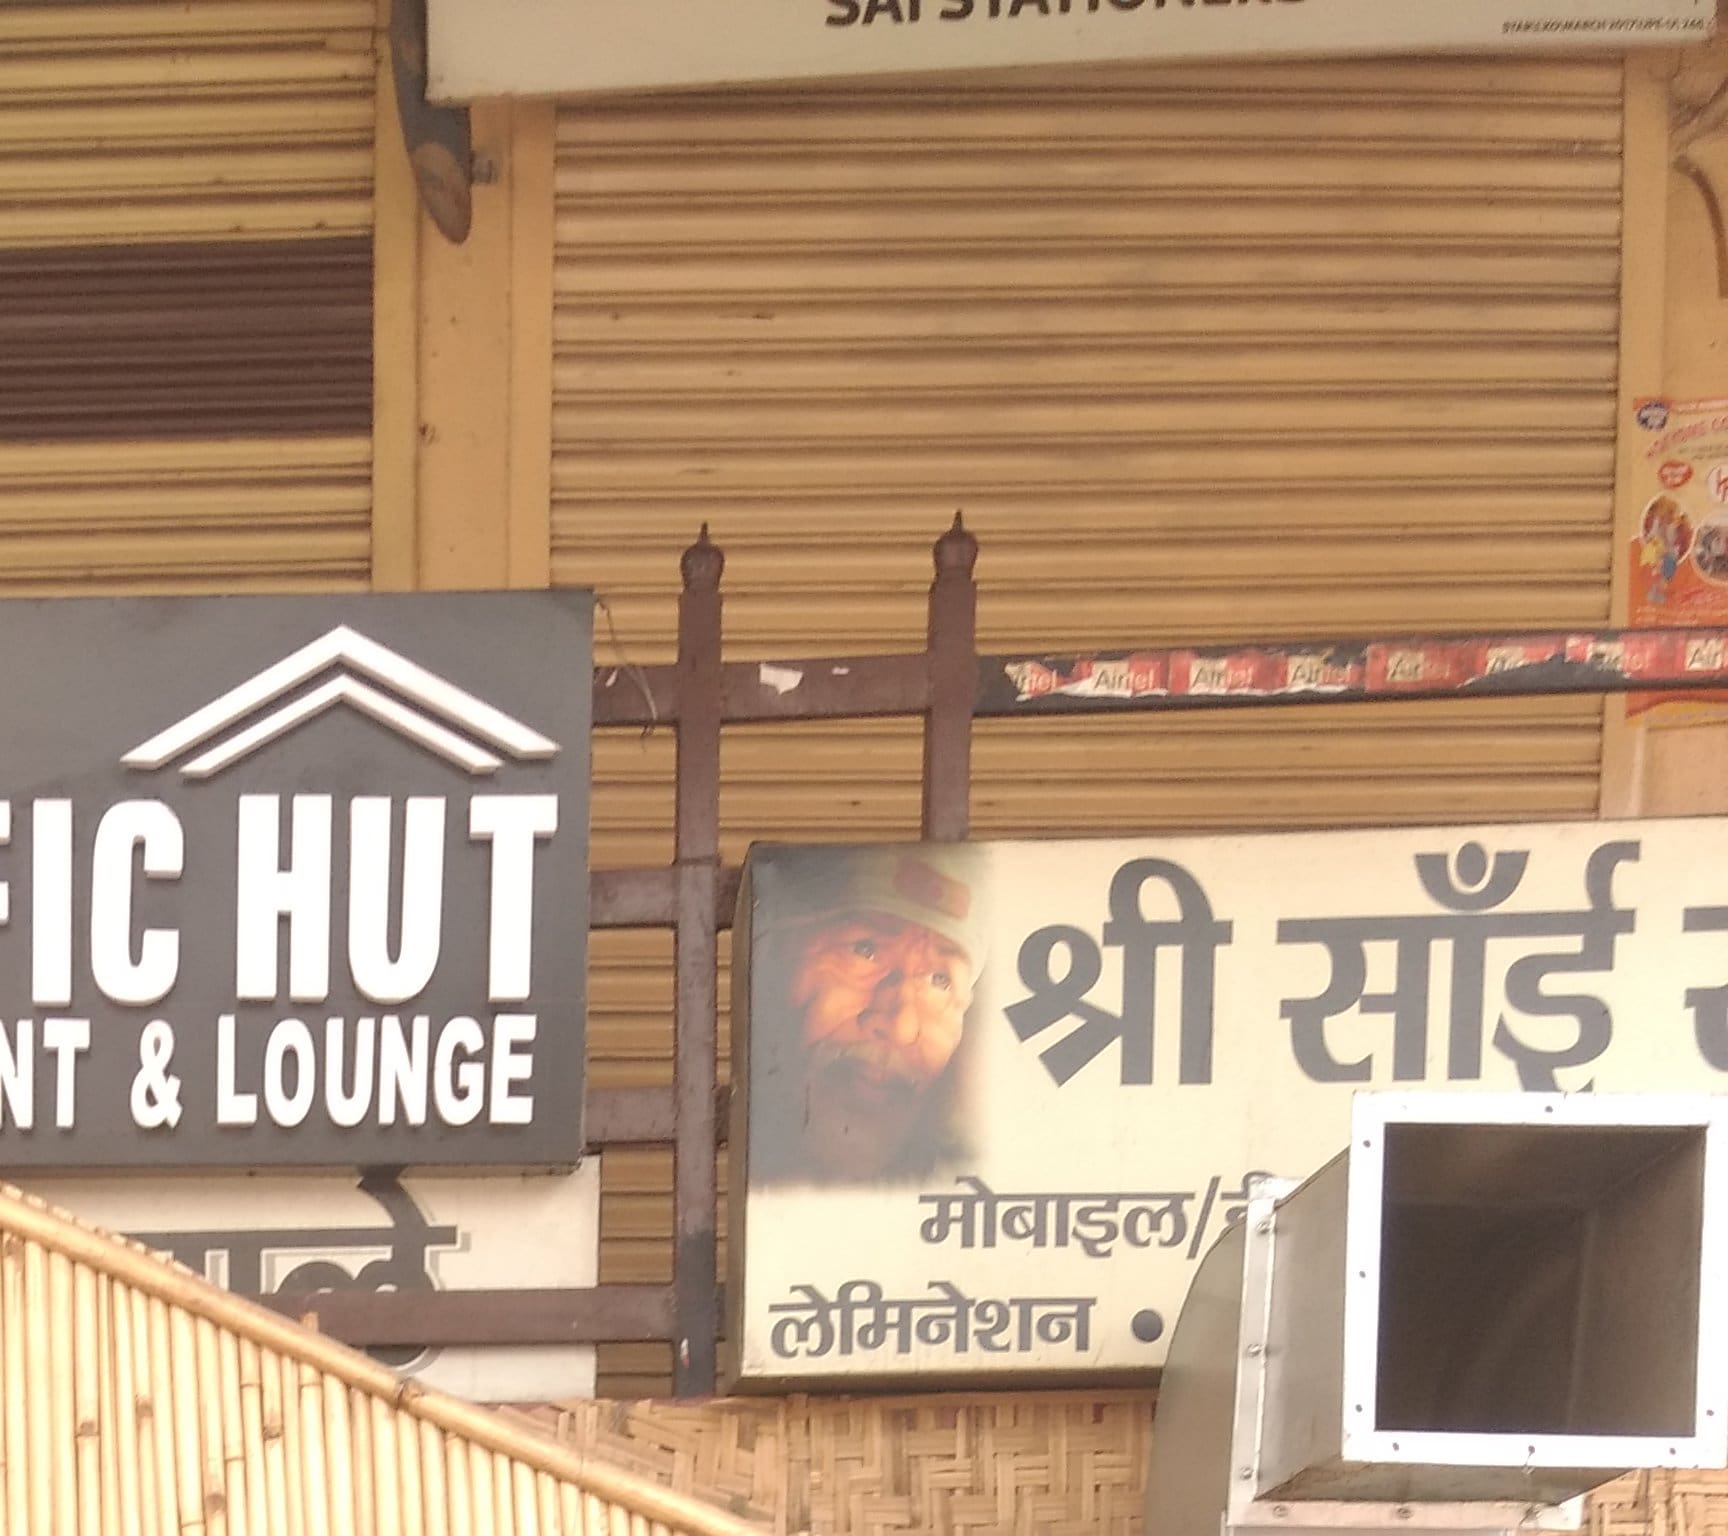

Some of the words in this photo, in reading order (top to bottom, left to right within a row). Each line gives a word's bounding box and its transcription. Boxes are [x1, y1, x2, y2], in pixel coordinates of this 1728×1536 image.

[235, 793, 559, 1002] HUT
[1002, 857, 1234, 1087] श्री
[129, 1018, 183, 1130] &
[215, 1014, 538, 1127] LOUNGE
[768, 1280, 1097, 1359] लेमिनेशन
